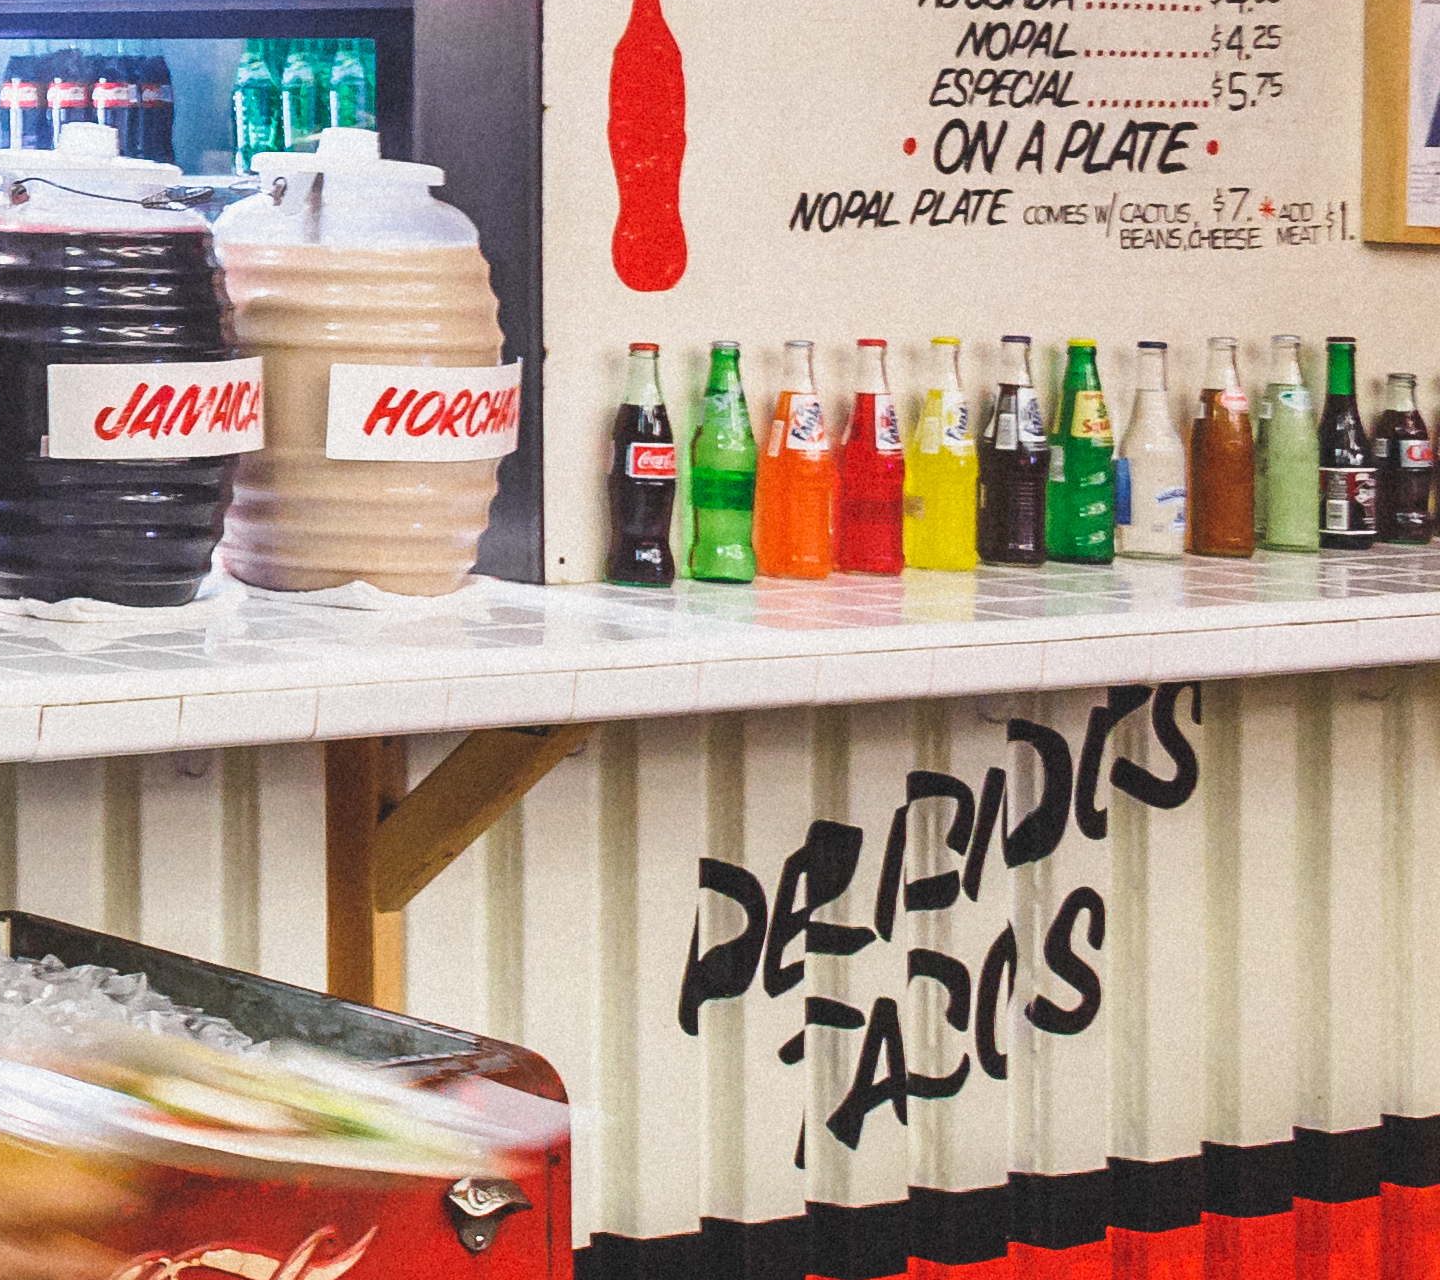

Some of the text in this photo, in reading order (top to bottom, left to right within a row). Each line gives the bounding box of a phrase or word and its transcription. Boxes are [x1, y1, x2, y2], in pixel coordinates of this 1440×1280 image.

[956, 20, 1283, 62] NOPAL $4.25
[929, 69, 1285, 110] ESPECIAL $5.75
[932, 120, 1200, 177] ON A PLATE
[788, 188, 903, 234] NOPAL
[909, 187, 1014, 229] PLATE
[1021, 202, 1088, 226] COMES
[93, 379, 262, 441] JAMAICA
[776, 885, 1107, 1171] TACOS
